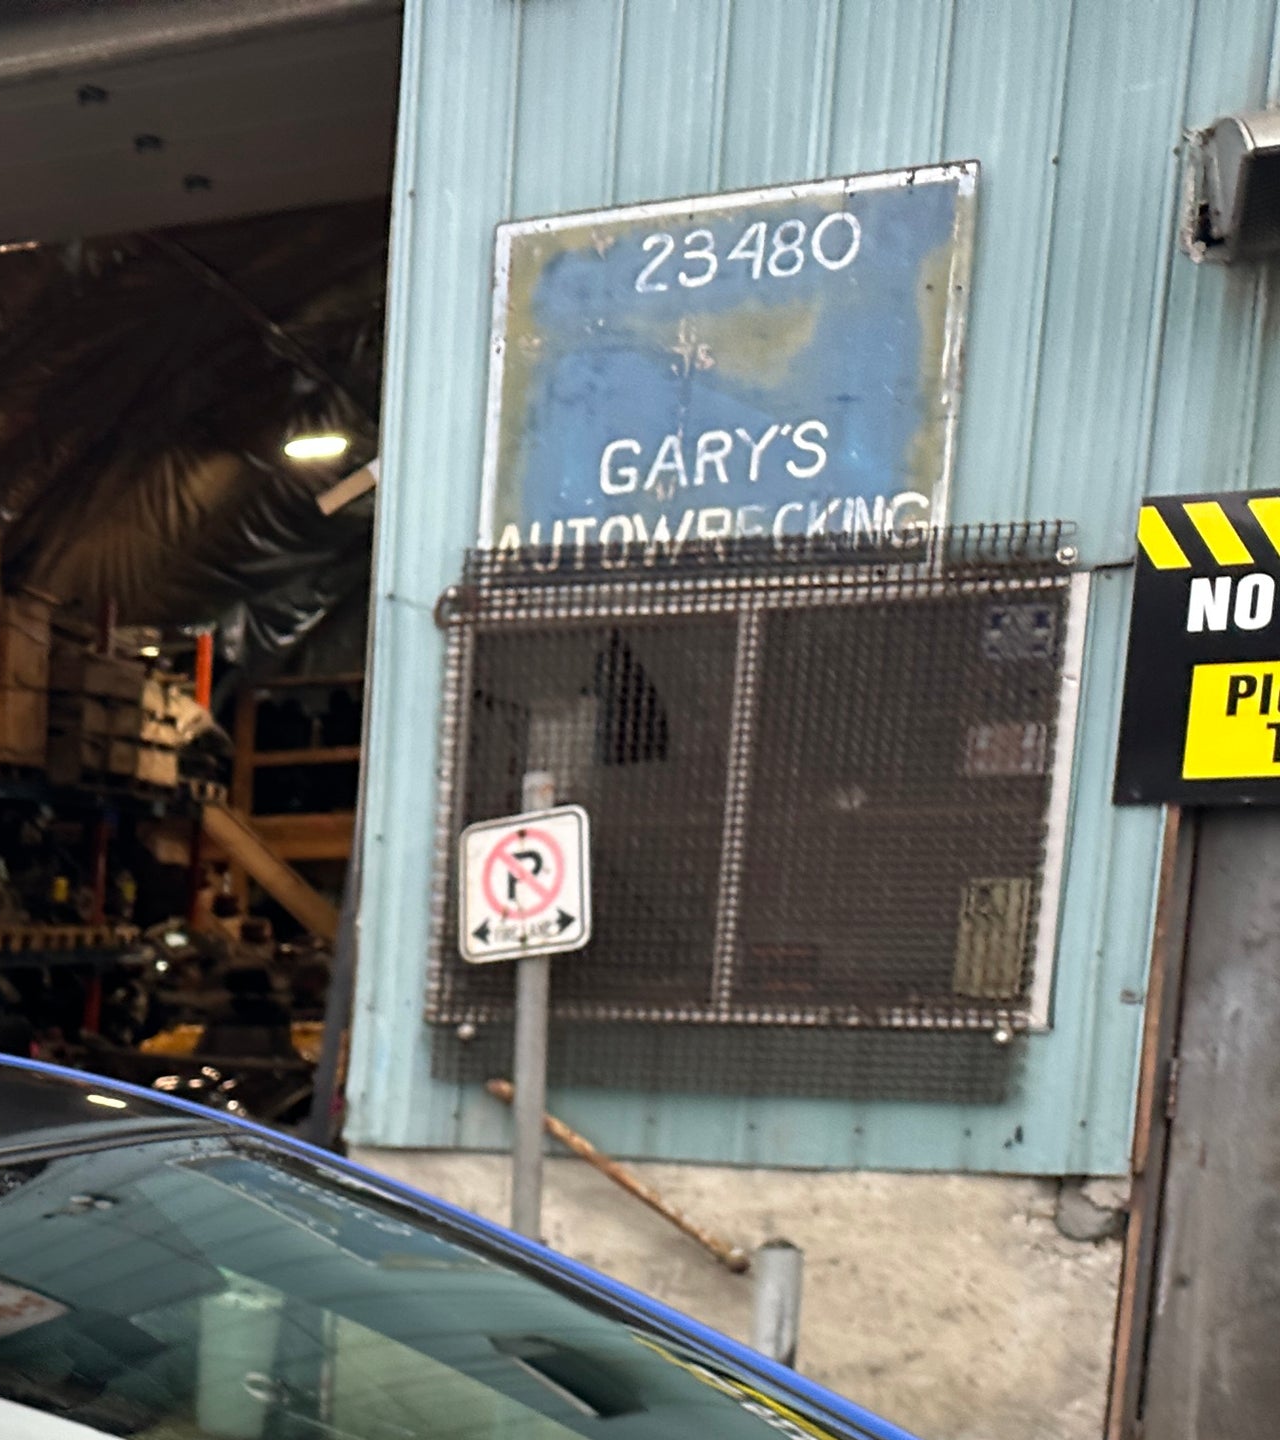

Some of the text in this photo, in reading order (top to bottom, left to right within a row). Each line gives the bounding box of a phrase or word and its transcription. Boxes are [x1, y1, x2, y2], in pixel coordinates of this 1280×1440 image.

[635, 211, 861, 293] 23480
[600, 420, 829, 495] GARY'S
[1187, 573, 1275, 632] NO
[1226, 673, 1280, 717] PI
